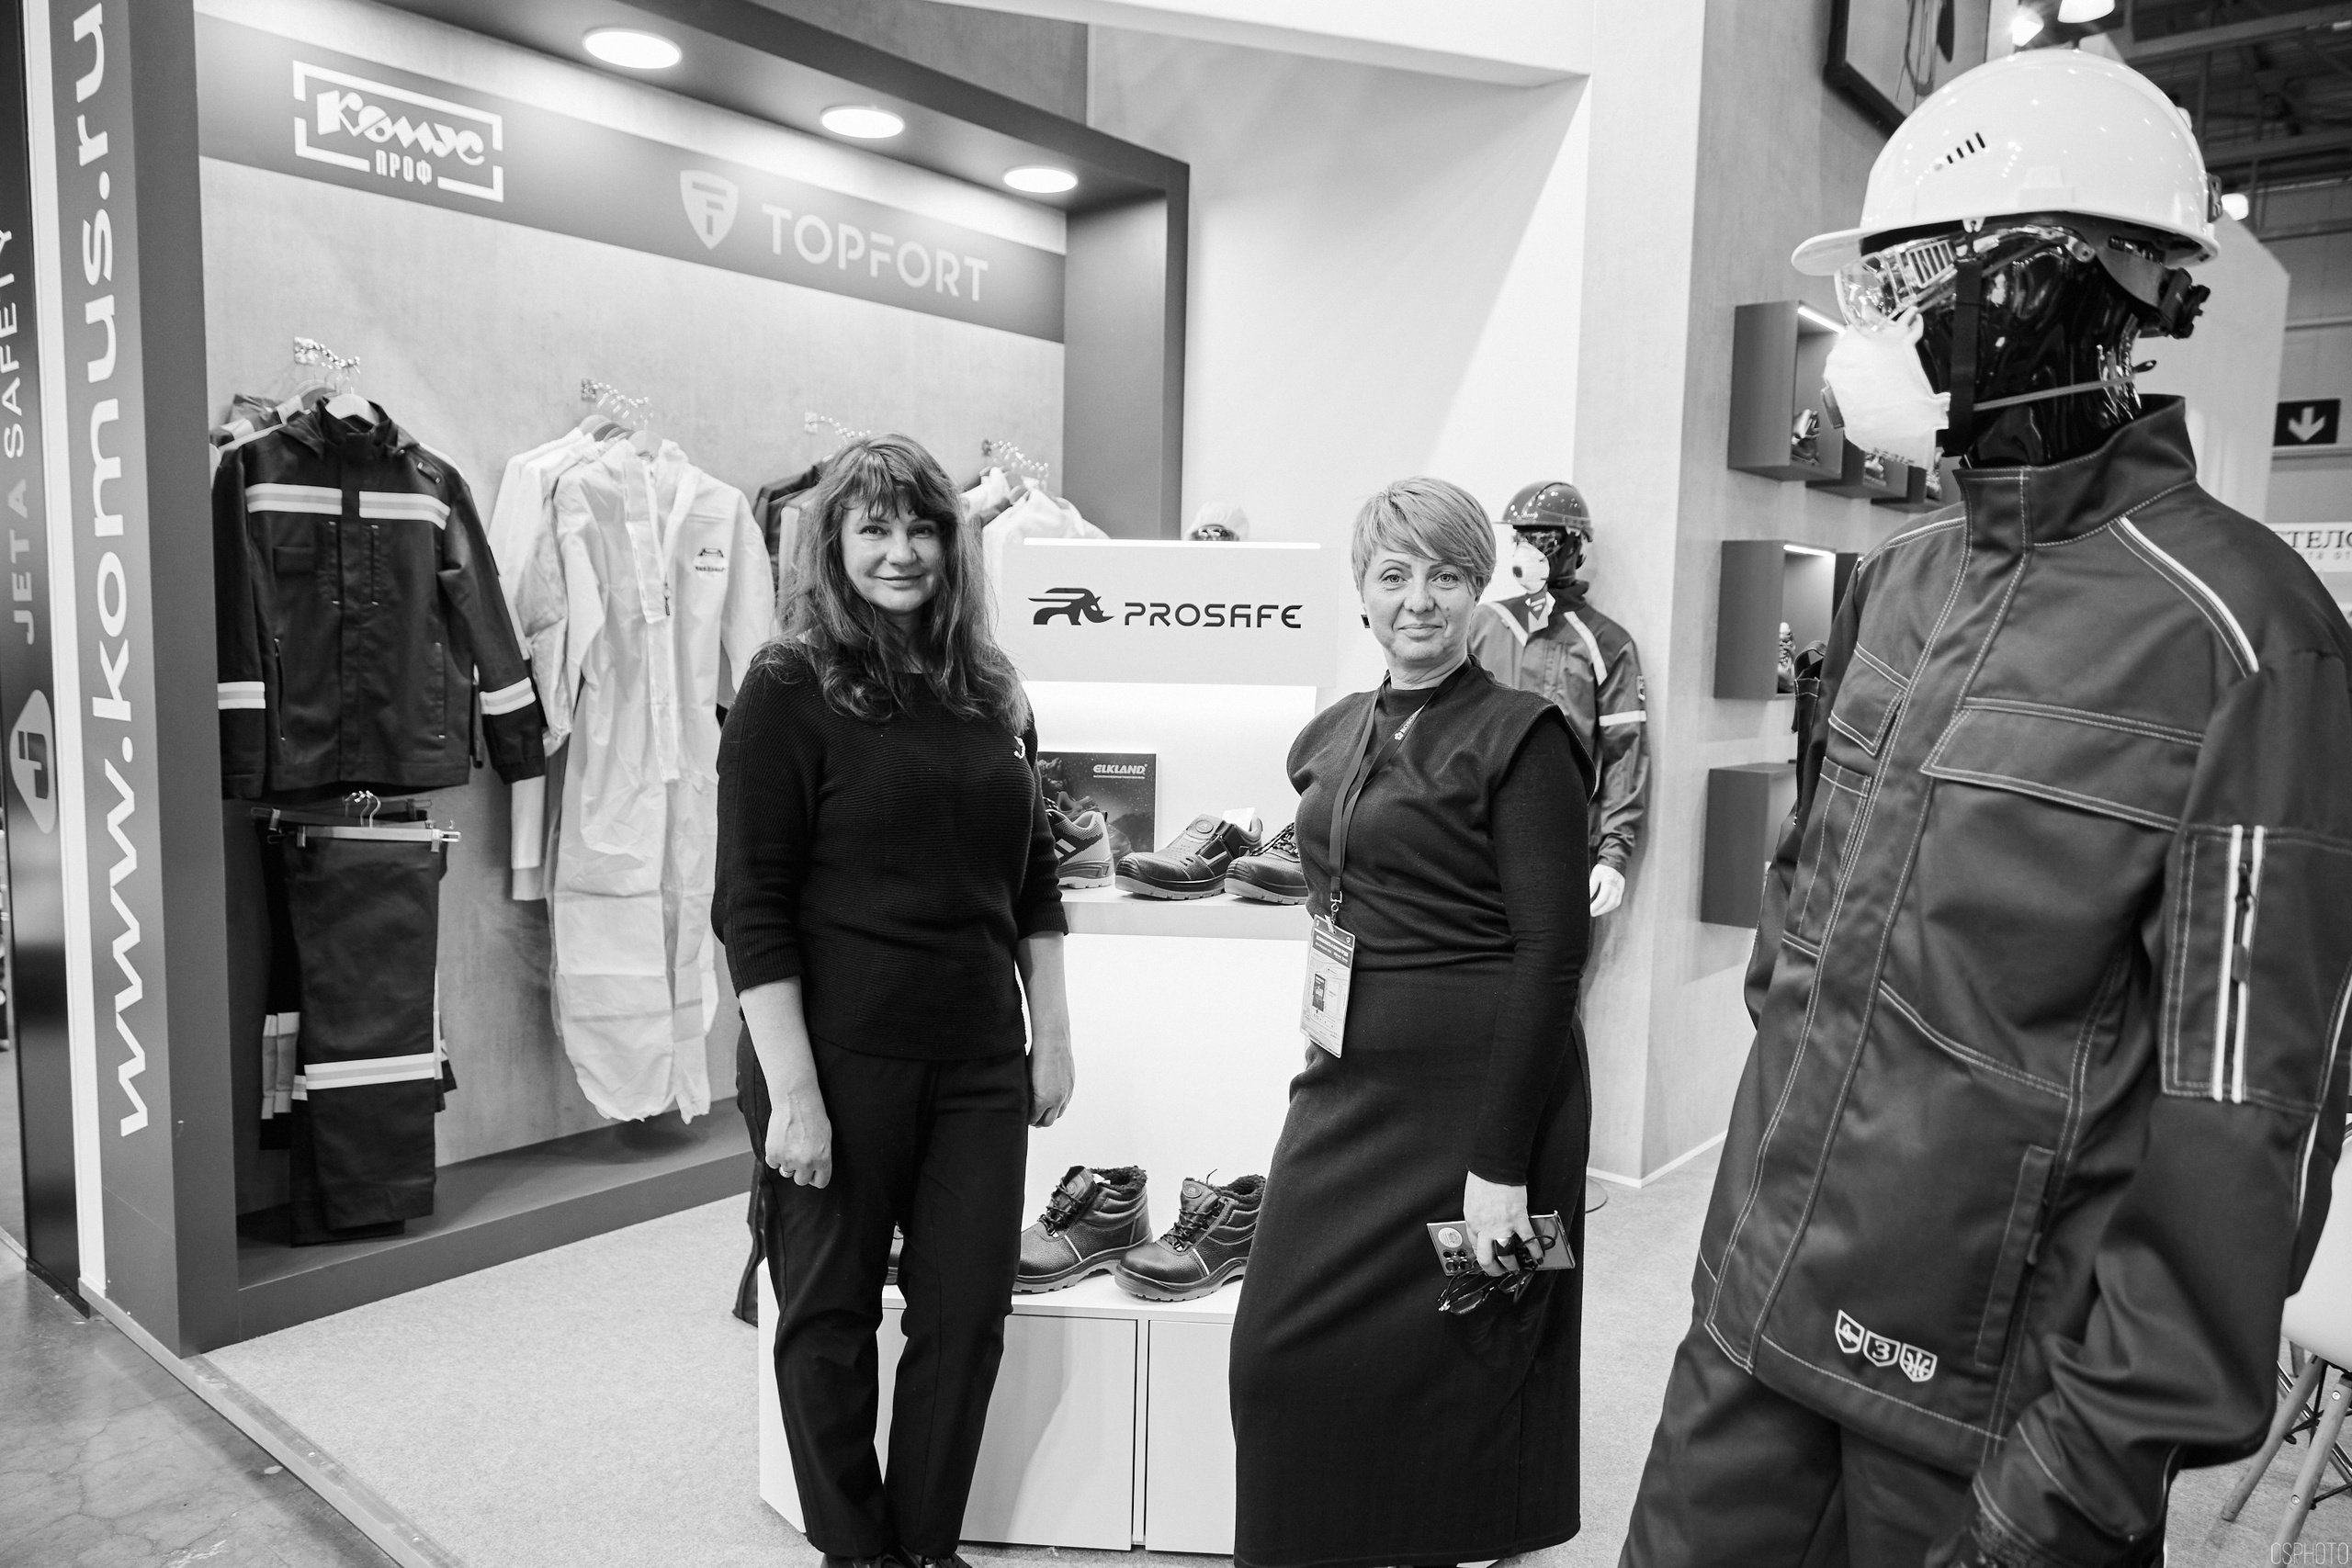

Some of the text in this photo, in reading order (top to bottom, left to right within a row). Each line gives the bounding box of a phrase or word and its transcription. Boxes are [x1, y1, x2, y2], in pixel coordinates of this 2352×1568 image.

[375, 149, 433, 186] ПРОФ
[762, 202, 989, 302] TOPFORT
[8, 479, 34, 644] JETA
[73, 3, 149, 1137] www.komus.ru
[1125, 602, 1304, 629] PROSAFE
[1093, 764, 1146, 774] ELKLAND
